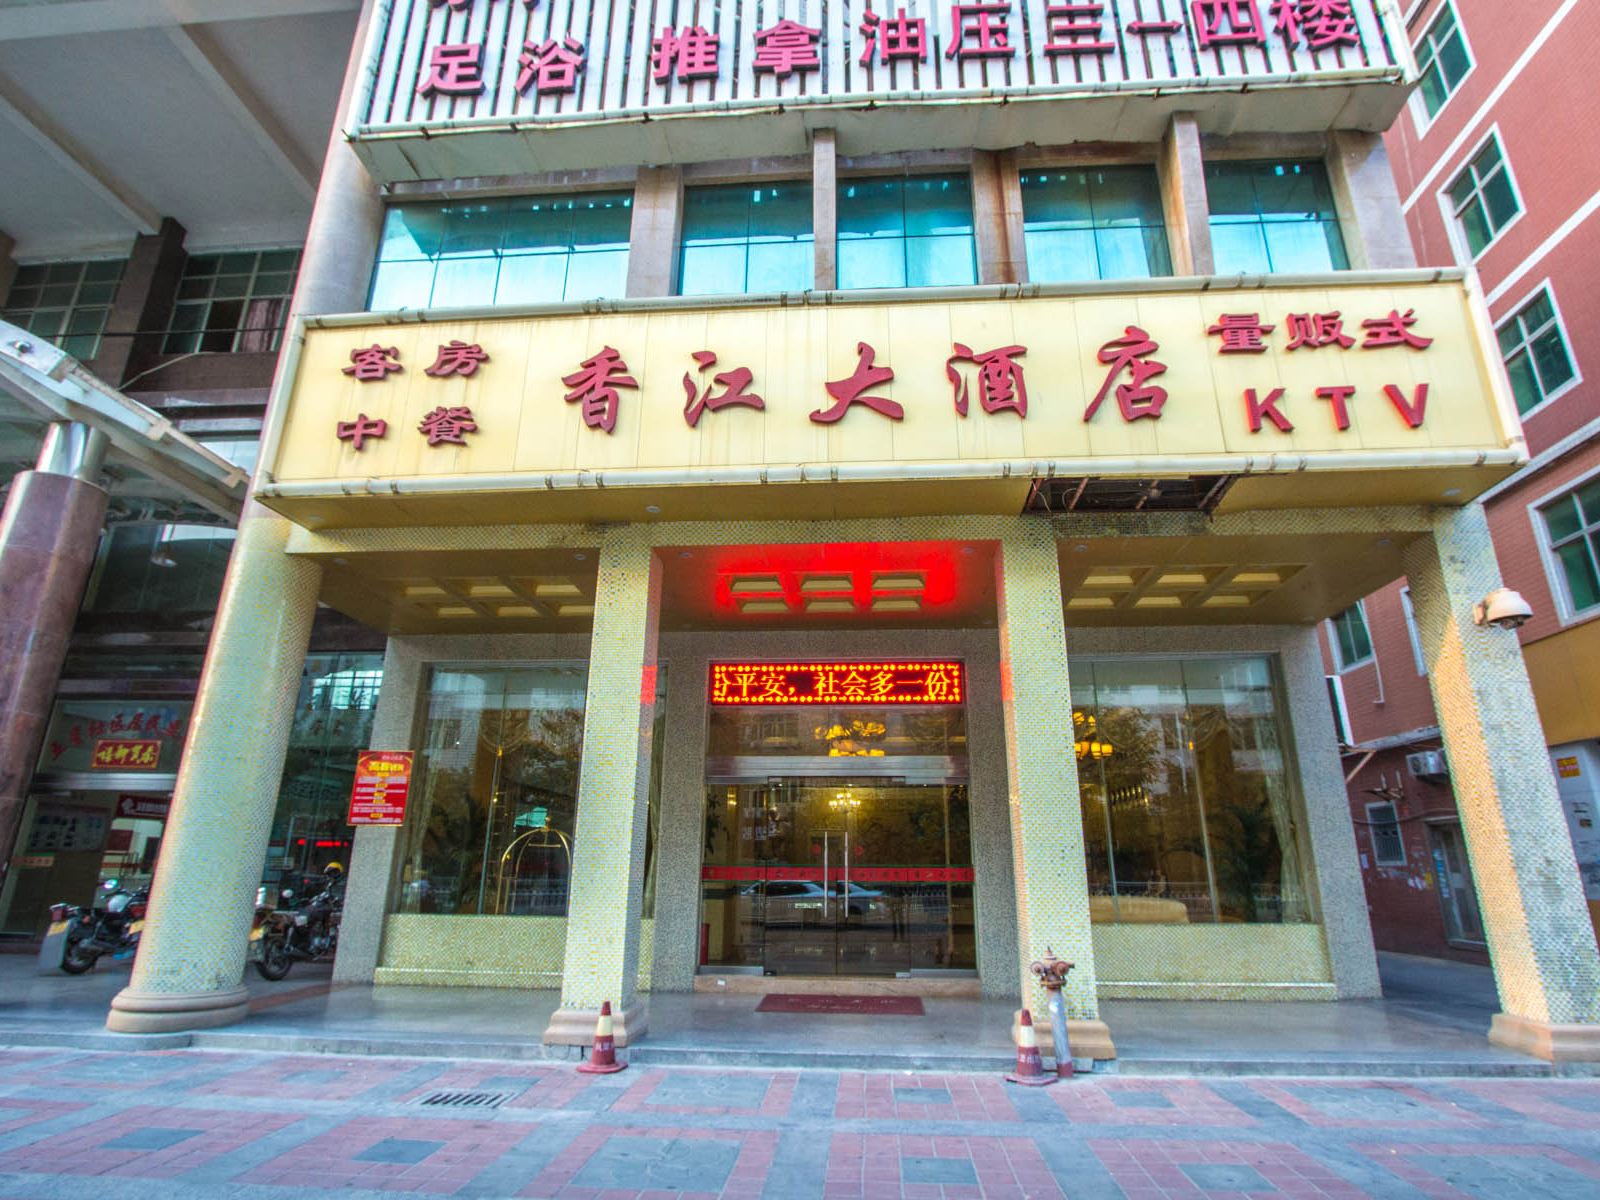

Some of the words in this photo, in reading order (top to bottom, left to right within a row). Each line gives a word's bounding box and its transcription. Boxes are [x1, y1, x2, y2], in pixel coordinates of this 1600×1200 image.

[1206, 308, 1434, 354] 量贩式
[341, 340, 490, 382] 客房
[561, 325, 1169, 434] 香江大酒店
[336, 406, 478, 450] 中餐
[1243, 382, 1430, 433] KTV
